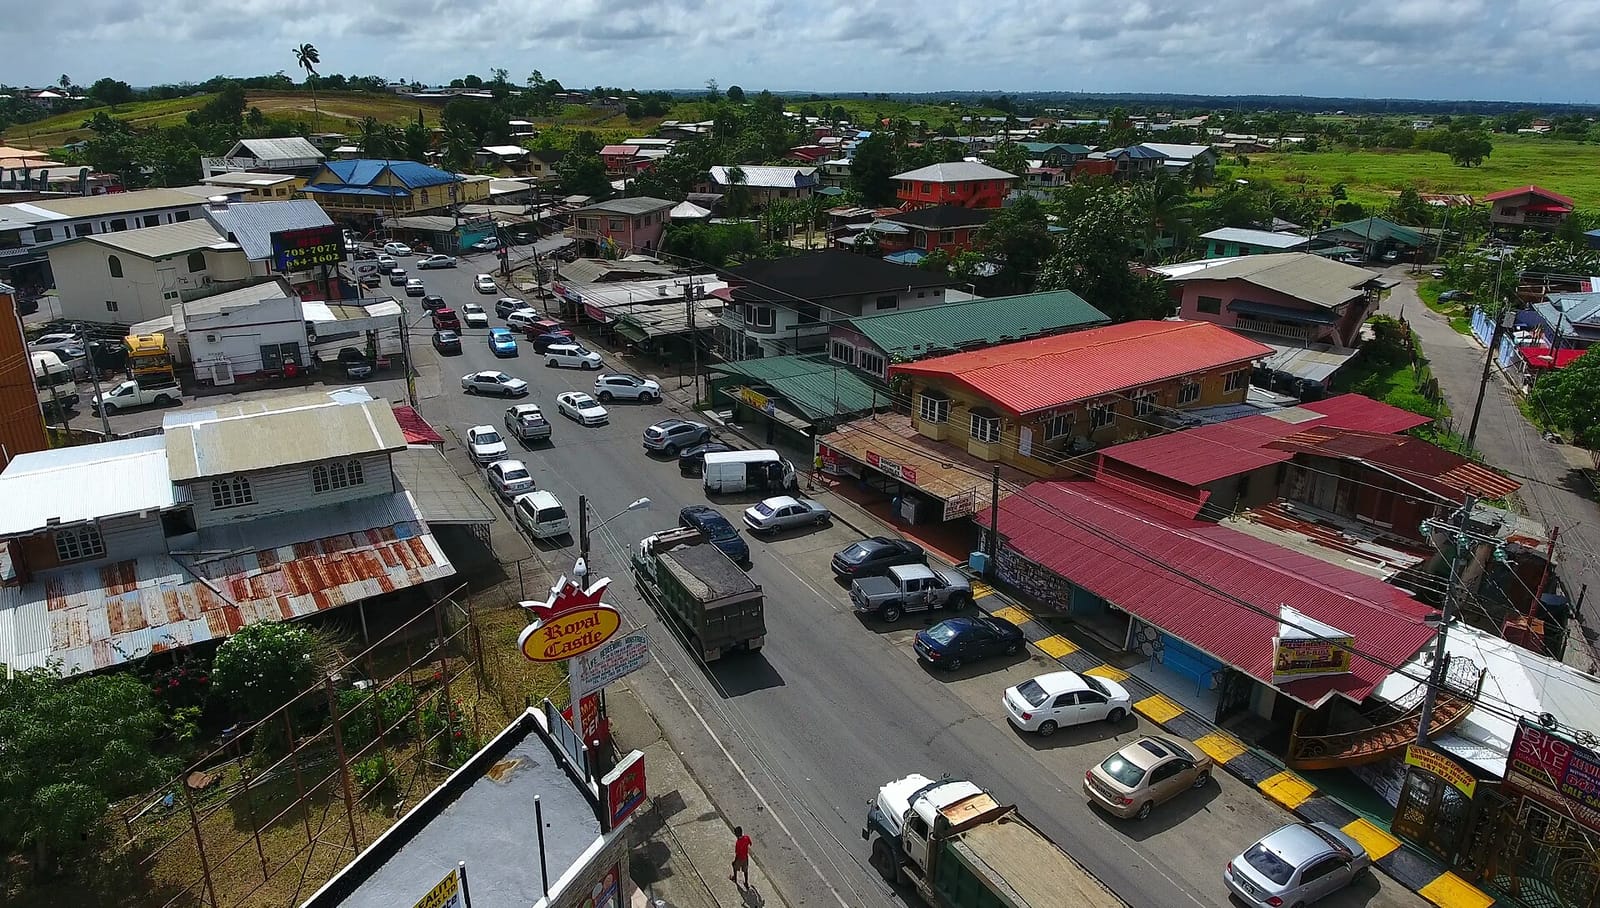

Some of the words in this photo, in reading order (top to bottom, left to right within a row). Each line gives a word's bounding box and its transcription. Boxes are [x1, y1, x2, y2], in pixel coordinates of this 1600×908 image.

[284, 243, 337, 258] 708-7077
[543, 612, 601, 643] Royal
[543, 630, 602, 658] Castle
[1518, 740, 1566, 770] SALE
[1522, 726, 1570, 757] BIG
[1410, 752, 1449, 771] SHOWROOM
